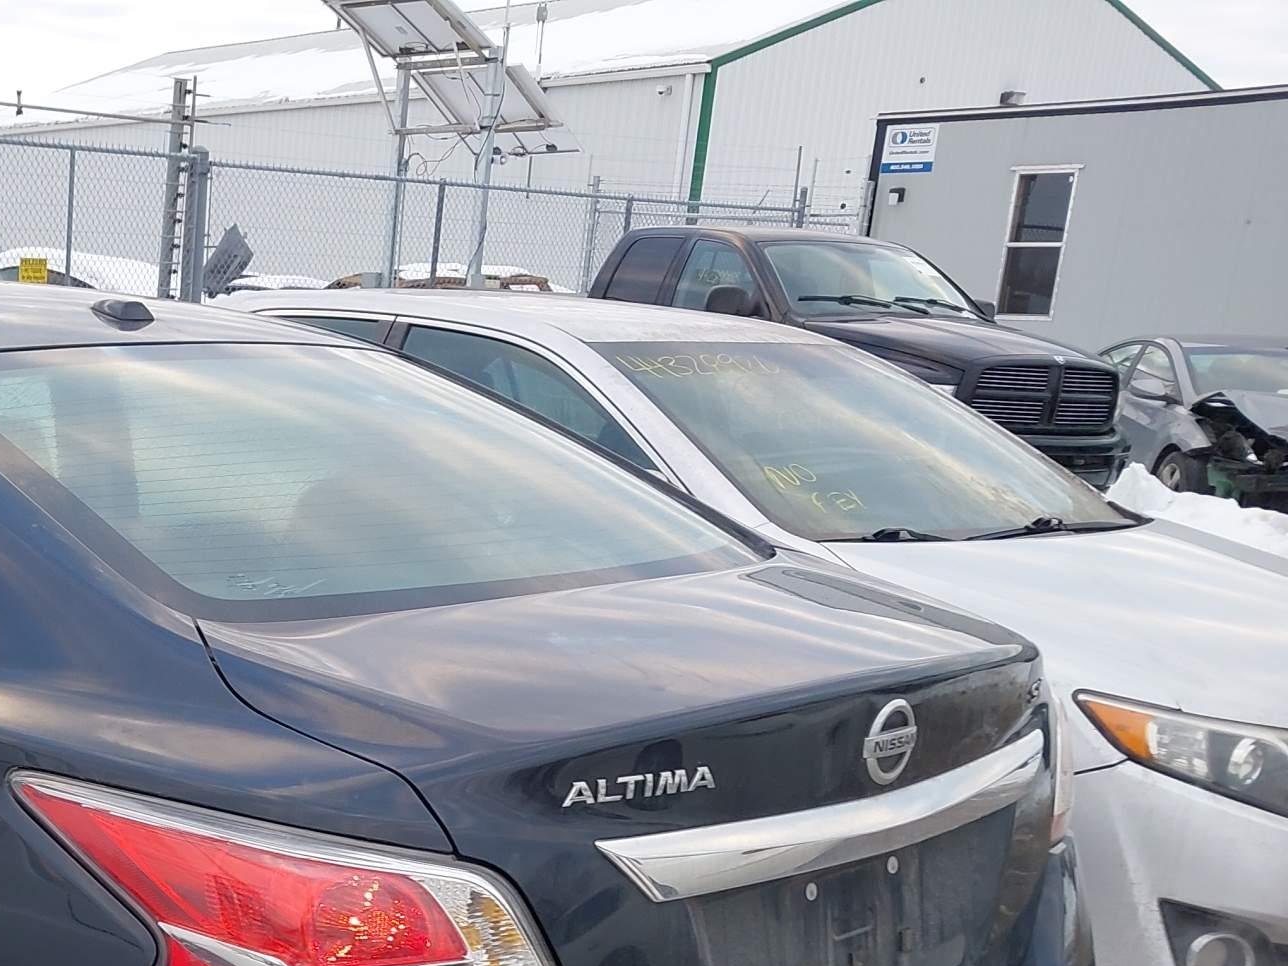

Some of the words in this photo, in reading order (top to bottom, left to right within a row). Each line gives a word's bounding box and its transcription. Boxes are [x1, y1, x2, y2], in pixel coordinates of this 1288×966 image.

[907, 130, 931, 138] United
[763, 463, 817, 489] NO
[562, 765, 716, 808] ALTIMA
